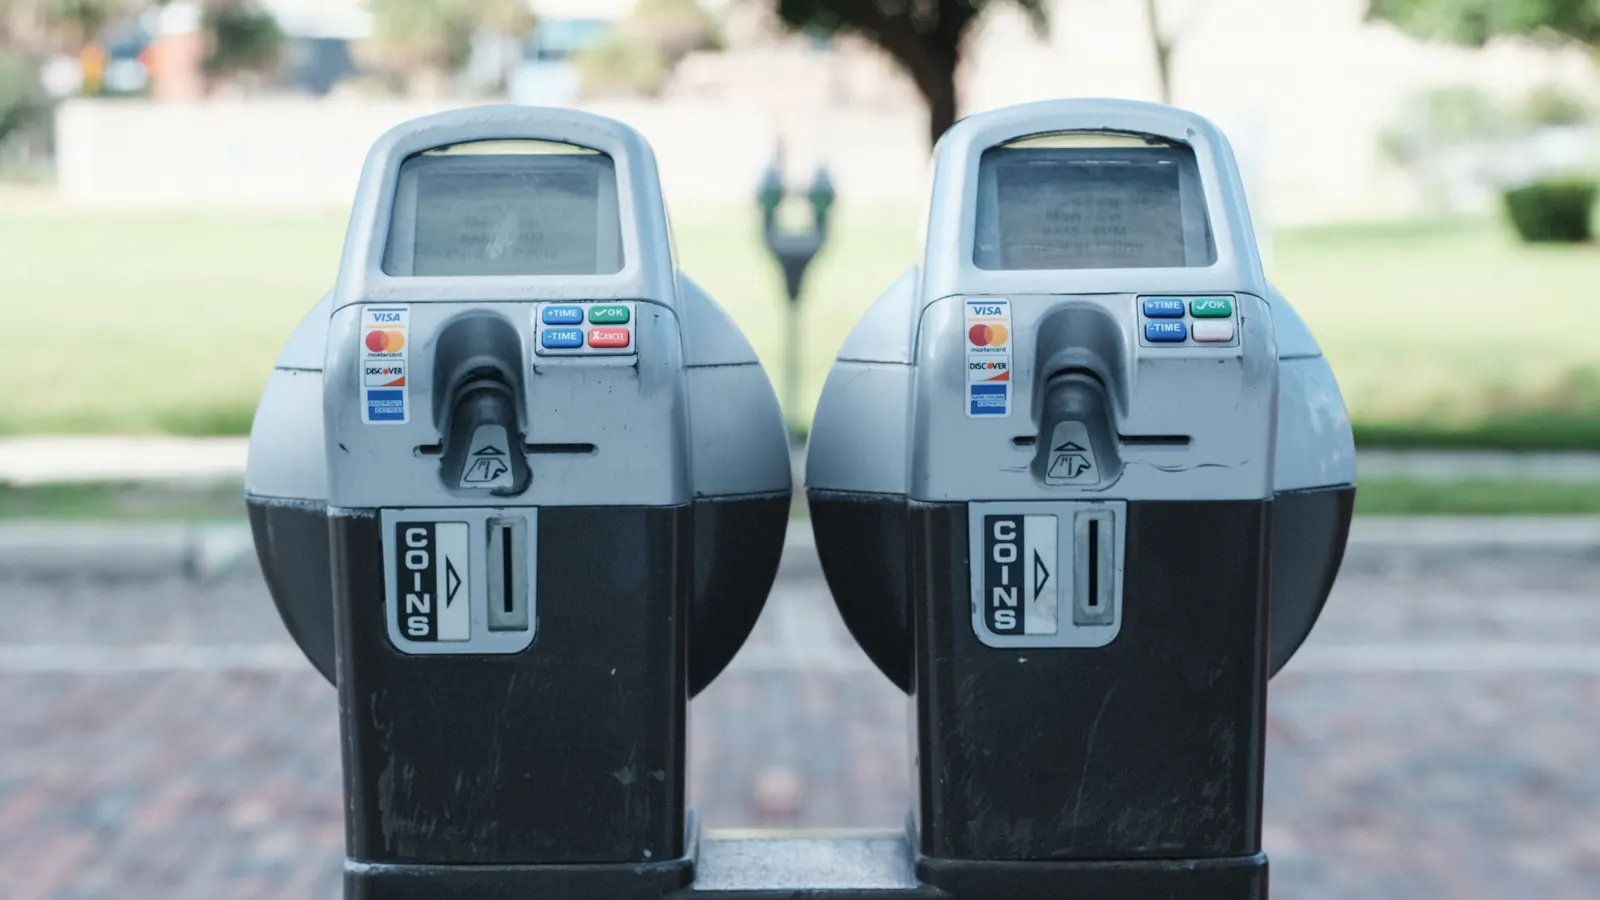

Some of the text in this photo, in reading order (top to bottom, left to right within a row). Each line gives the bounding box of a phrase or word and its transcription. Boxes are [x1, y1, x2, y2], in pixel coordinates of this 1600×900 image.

[1208, 300, 1226, 309] OK
[607, 308, 623, 317] OK
[973, 306, 1002, 315] VISA
[373, 313, 401, 322] VISA
[969, 362, 1007, 370] DISCOVER
[366, 367, 403, 375] DISCOVER
[993, 520, 1018, 630] COINS
[405, 527, 431, 636] COINS
